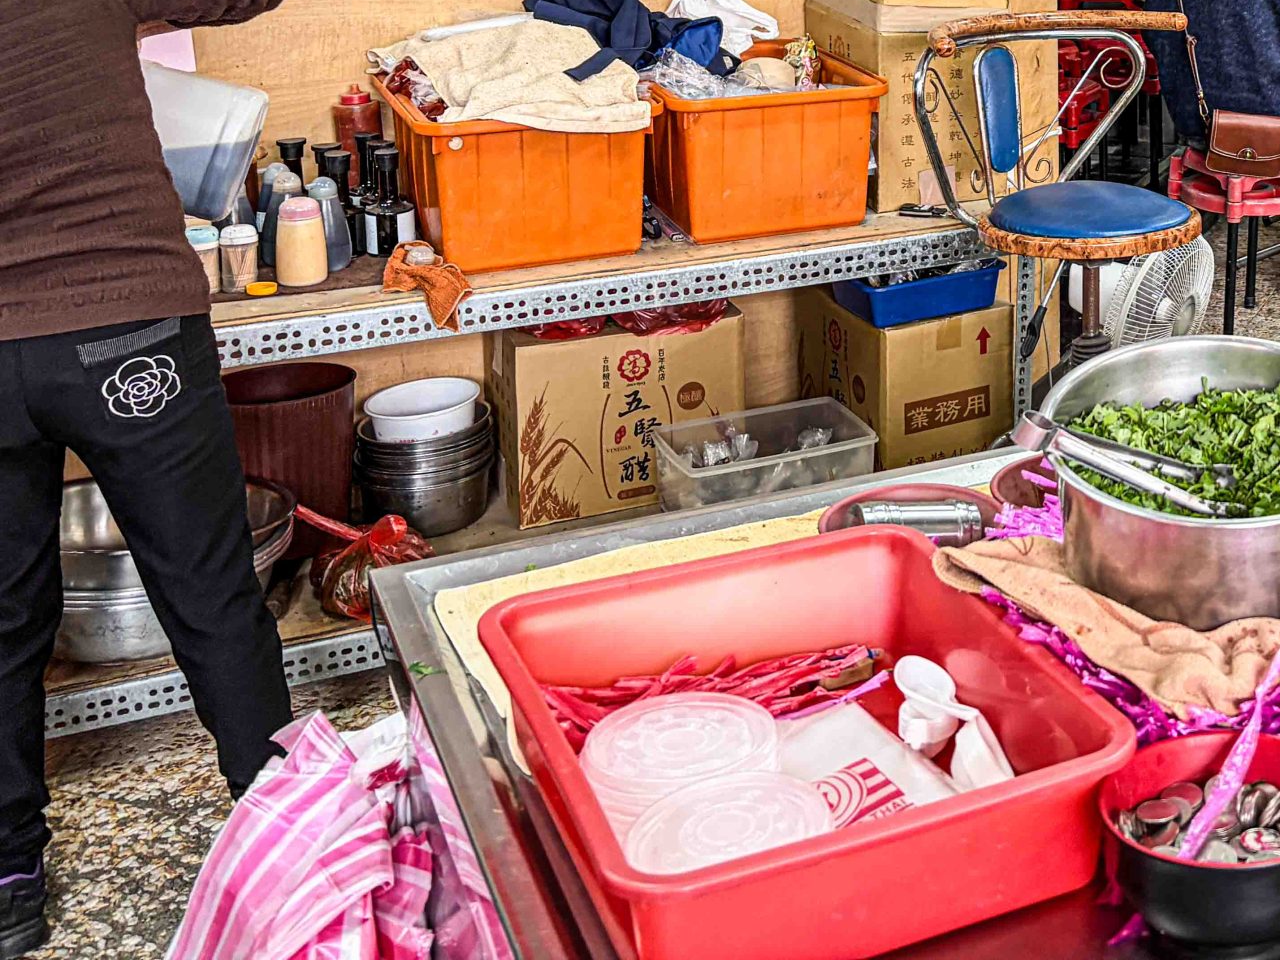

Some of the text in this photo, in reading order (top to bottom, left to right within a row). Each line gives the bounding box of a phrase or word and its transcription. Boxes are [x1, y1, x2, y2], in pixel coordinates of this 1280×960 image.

[618, 390, 662, 483] 五賢醋
[907, 394, 986, 428] 業務用
